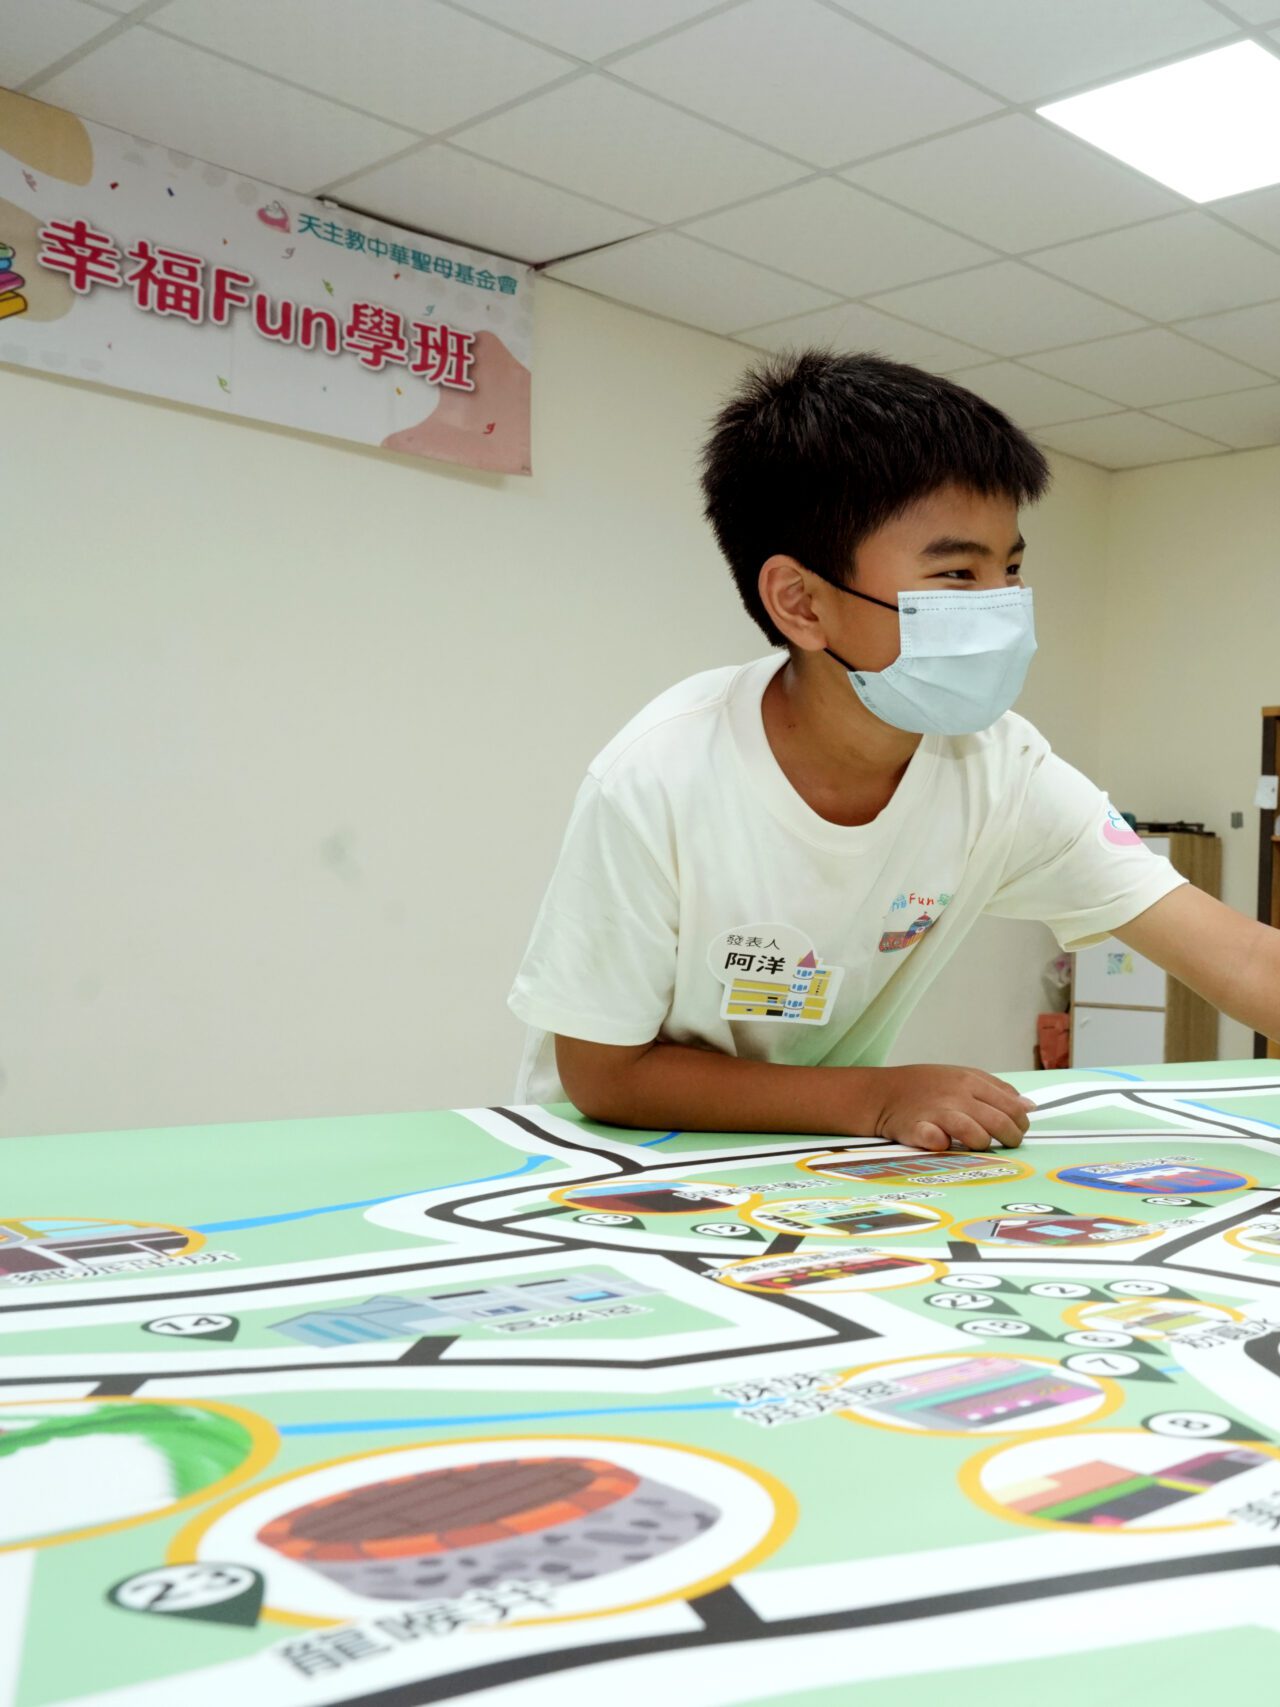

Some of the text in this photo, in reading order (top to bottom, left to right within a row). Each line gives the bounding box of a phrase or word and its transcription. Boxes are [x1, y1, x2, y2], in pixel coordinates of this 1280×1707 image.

[298, 213, 518, 296] 天主教中華聖母基金會
[38, 219, 477, 391] 幸福Fun學班
[727, 934, 781, 951] 發表人
[724, 951, 786, 976] 阿洋
[585, 1213, 629, 1224] 13
[702, 1223, 747, 1234] 12
[934, 1294, 989, 1309] 22
[156, 1316, 223, 1332] 14
[971, 1320, 1024, 1334] 18
[1085, 1356, 1121, 1371] 7
[1168, 1417, 1211, 1431] 8
[131, 1570, 241, 1609] 23
